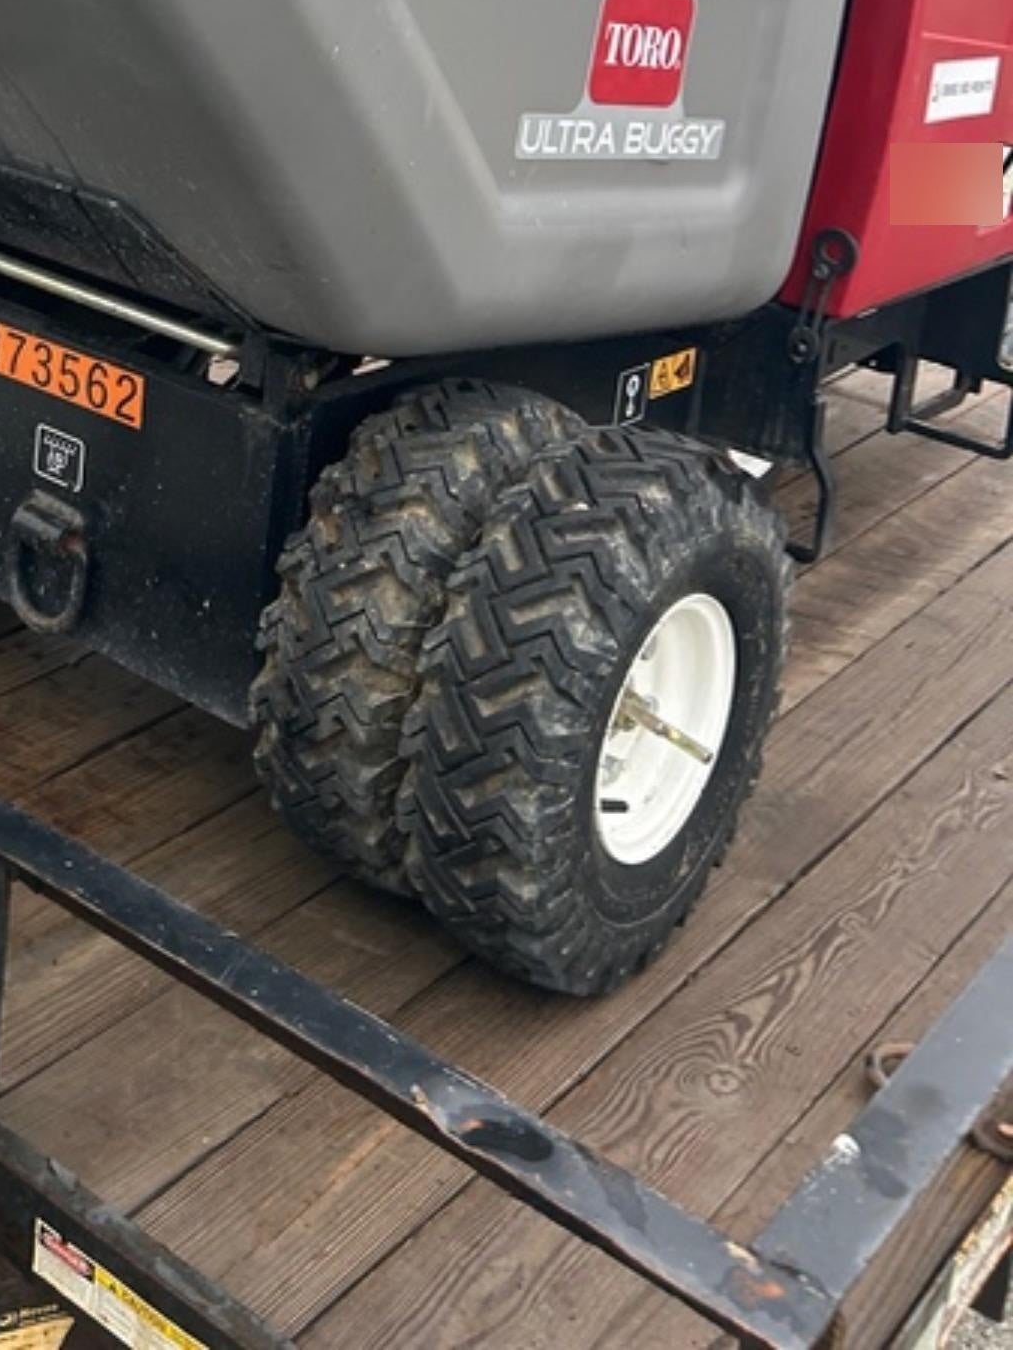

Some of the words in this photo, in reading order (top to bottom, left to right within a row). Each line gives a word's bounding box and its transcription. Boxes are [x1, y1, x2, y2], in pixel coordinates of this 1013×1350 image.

[605, 22, 681, 68] TORO
[520, 120, 615, 154] ULTRA
[624, 123, 721, 155] BUGGY
